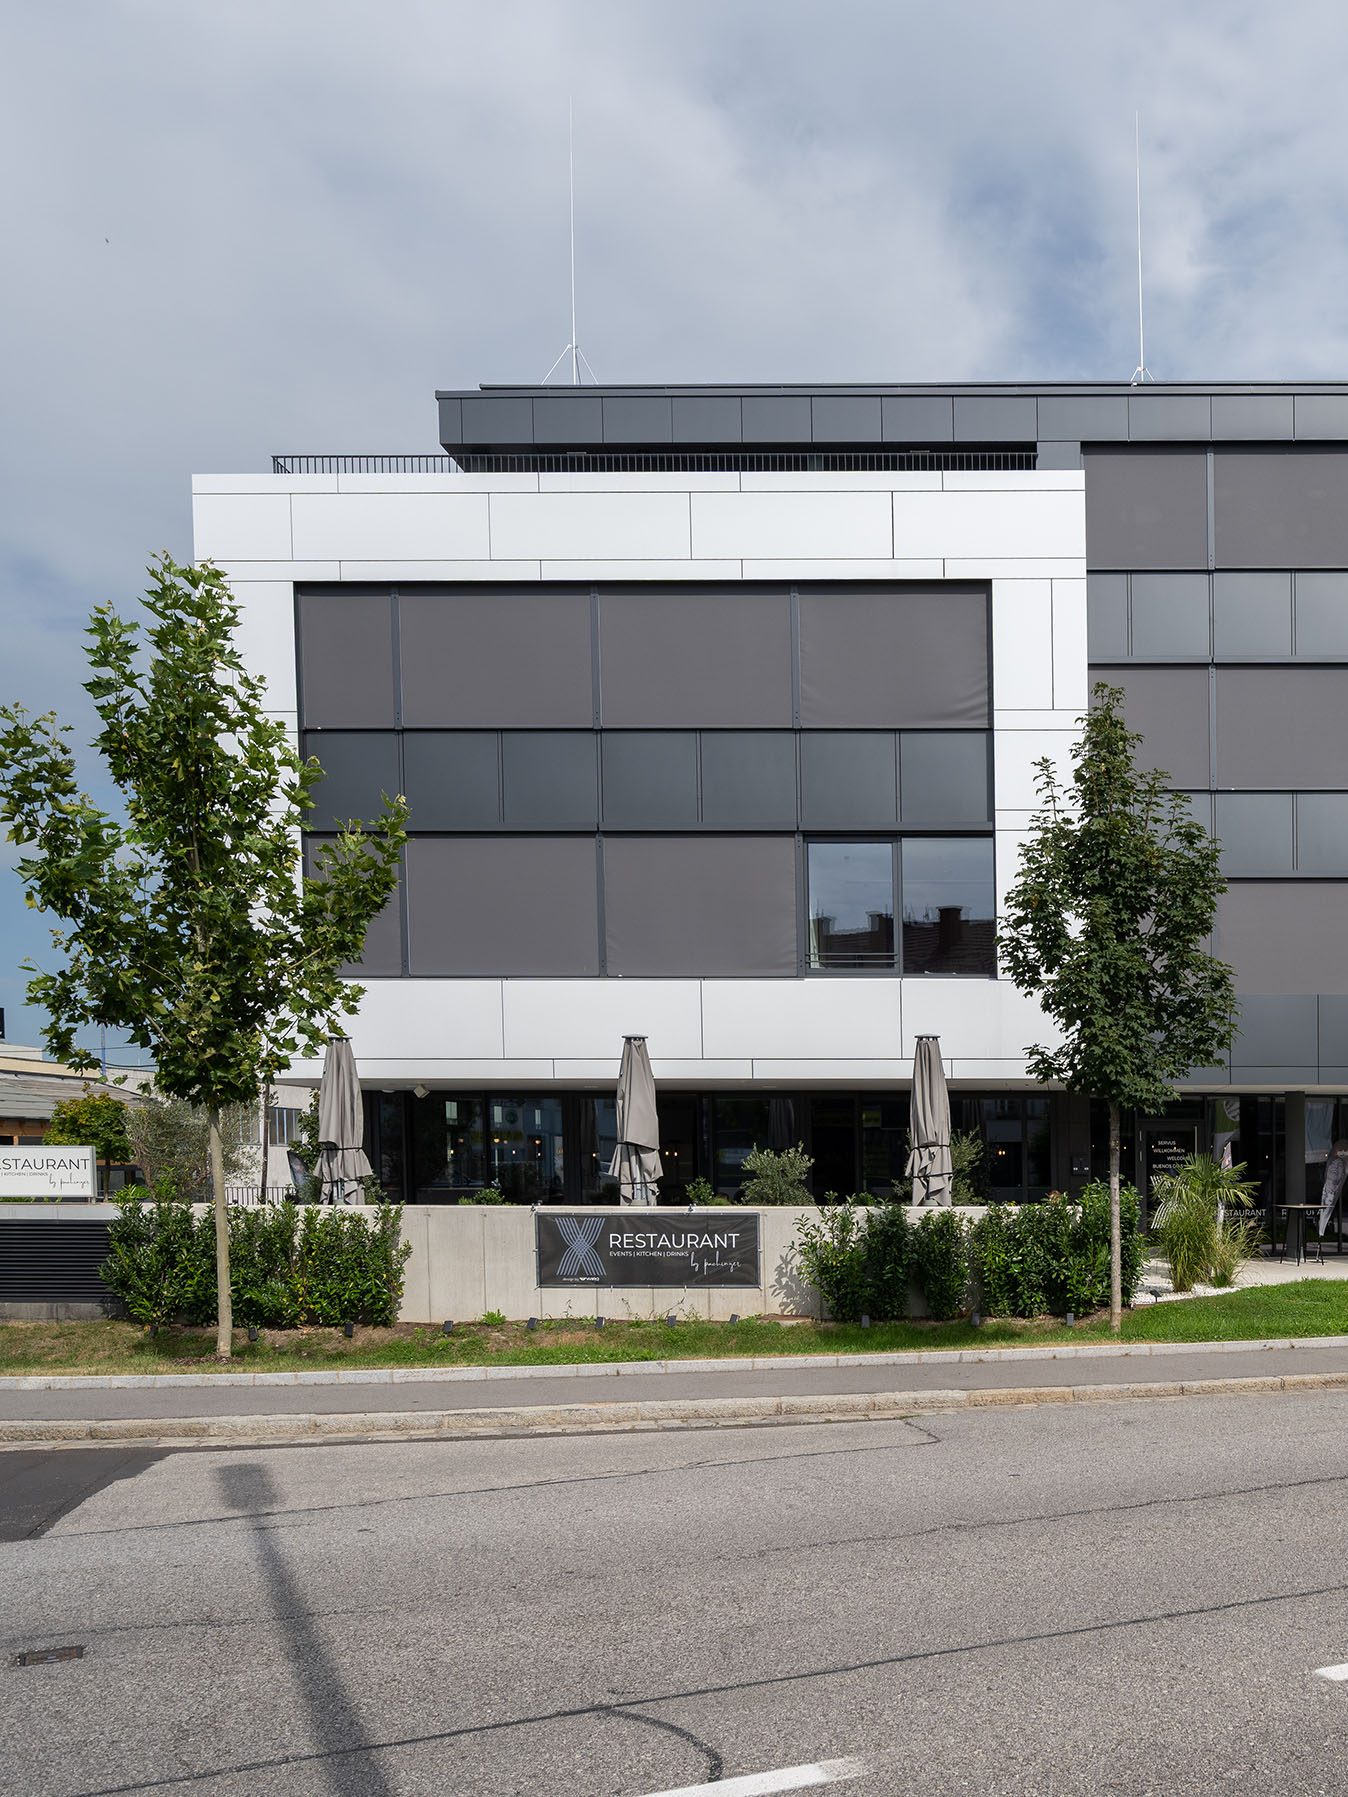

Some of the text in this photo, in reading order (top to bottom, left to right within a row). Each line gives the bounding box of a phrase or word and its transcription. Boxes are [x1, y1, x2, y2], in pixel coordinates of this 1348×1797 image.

[0, 1159, 90, 1170] STAURANT
[609, 1234, 739, 1248] RESTAURANT
[690, 1251, 700, 1272] by
